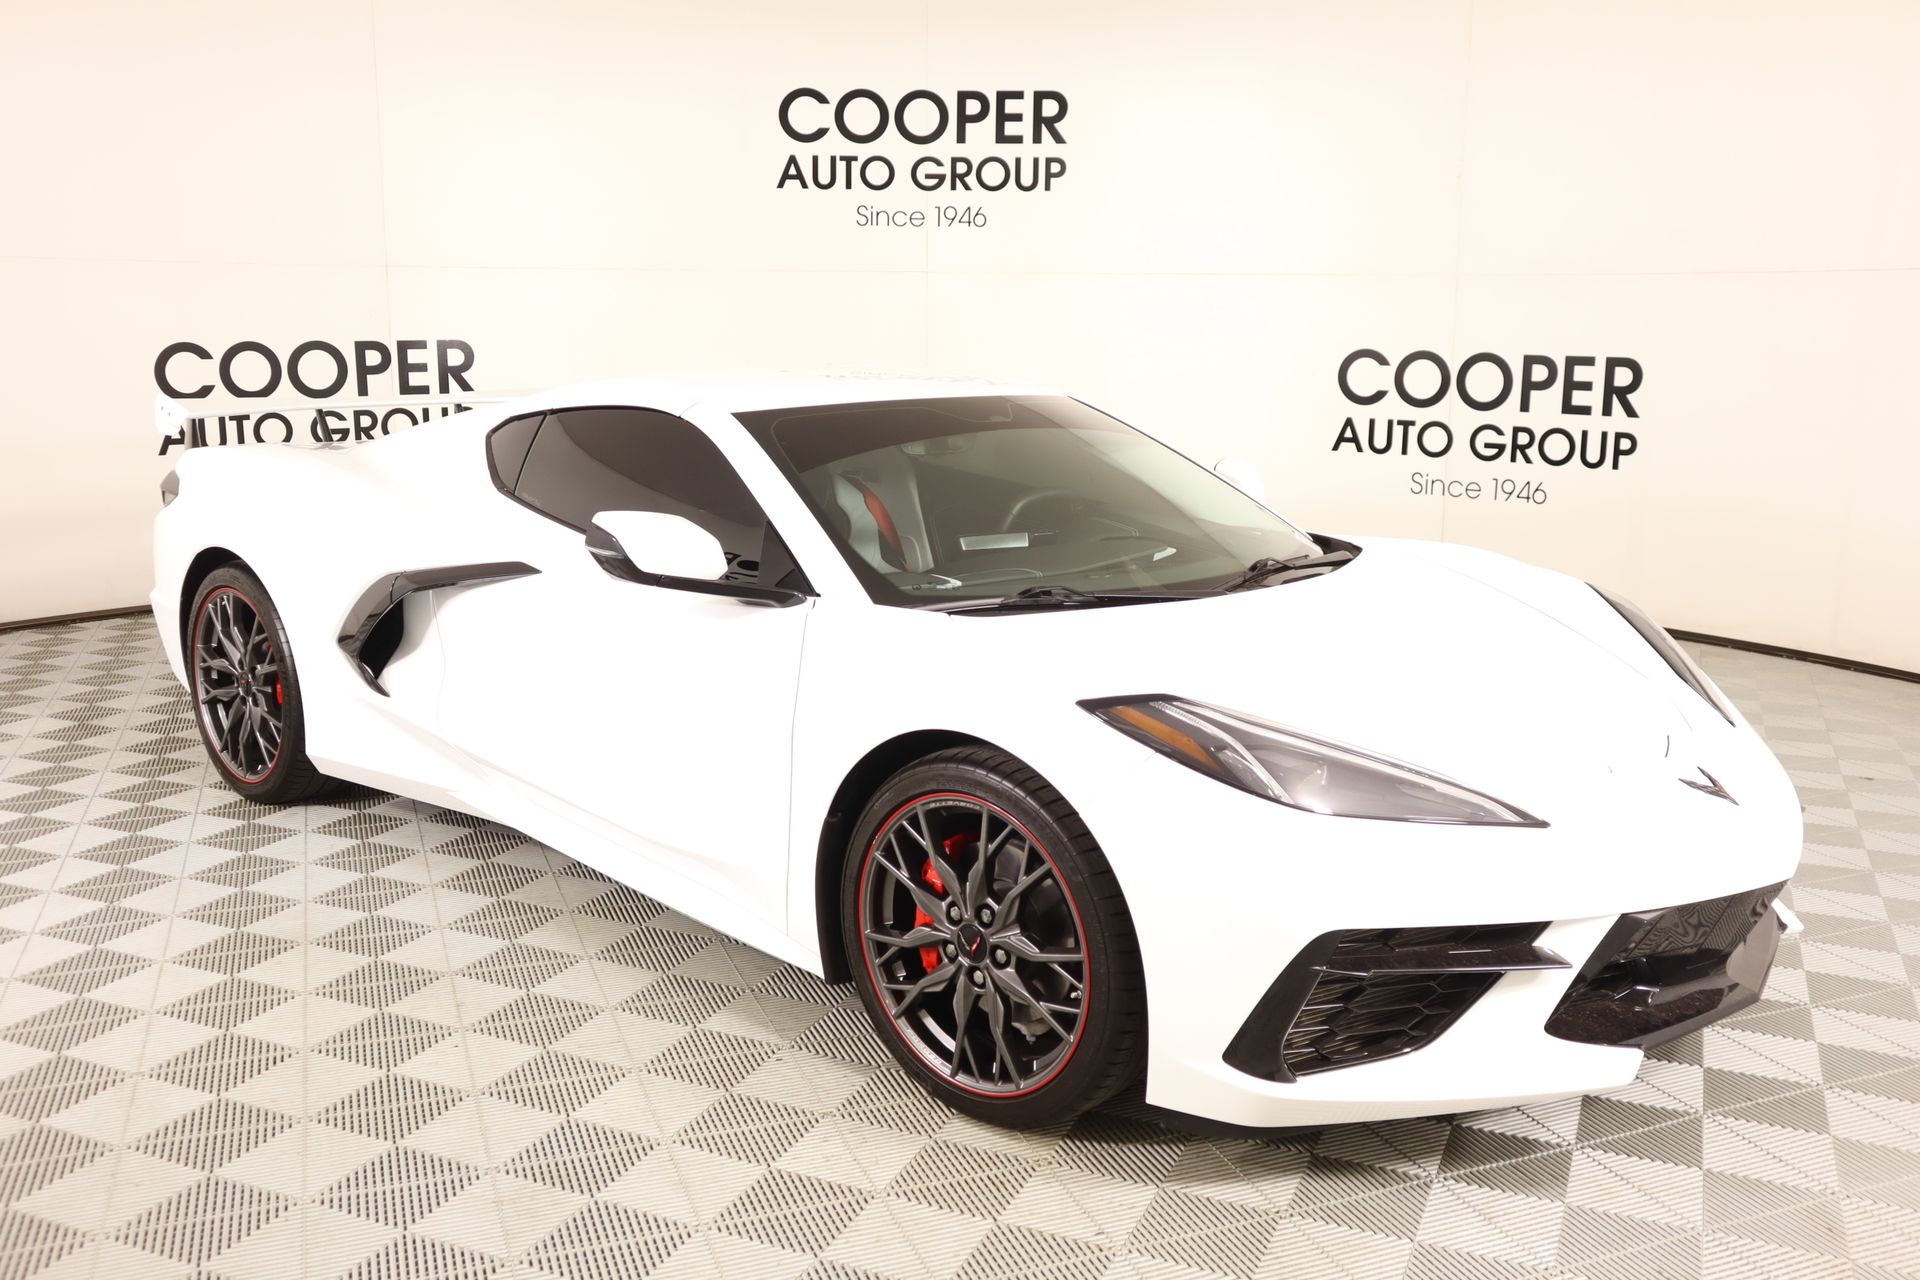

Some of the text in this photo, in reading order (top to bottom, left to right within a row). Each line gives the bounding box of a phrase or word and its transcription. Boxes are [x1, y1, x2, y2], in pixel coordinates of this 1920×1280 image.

[778, 87, 1069, 145] COOPER
[776, 154, 1067, 192] AUTO GROUP
[856, 204, 987, 228] Since 1946
[153, 339, 475, 399] COOPER
[1337, 348, 1644, 419] COOPER
[310, 406, 474, 443] GRO
[1331, 416, 1638, 471] AUTO GROUP
[1410, 471, 1548, 505] Since 1946
